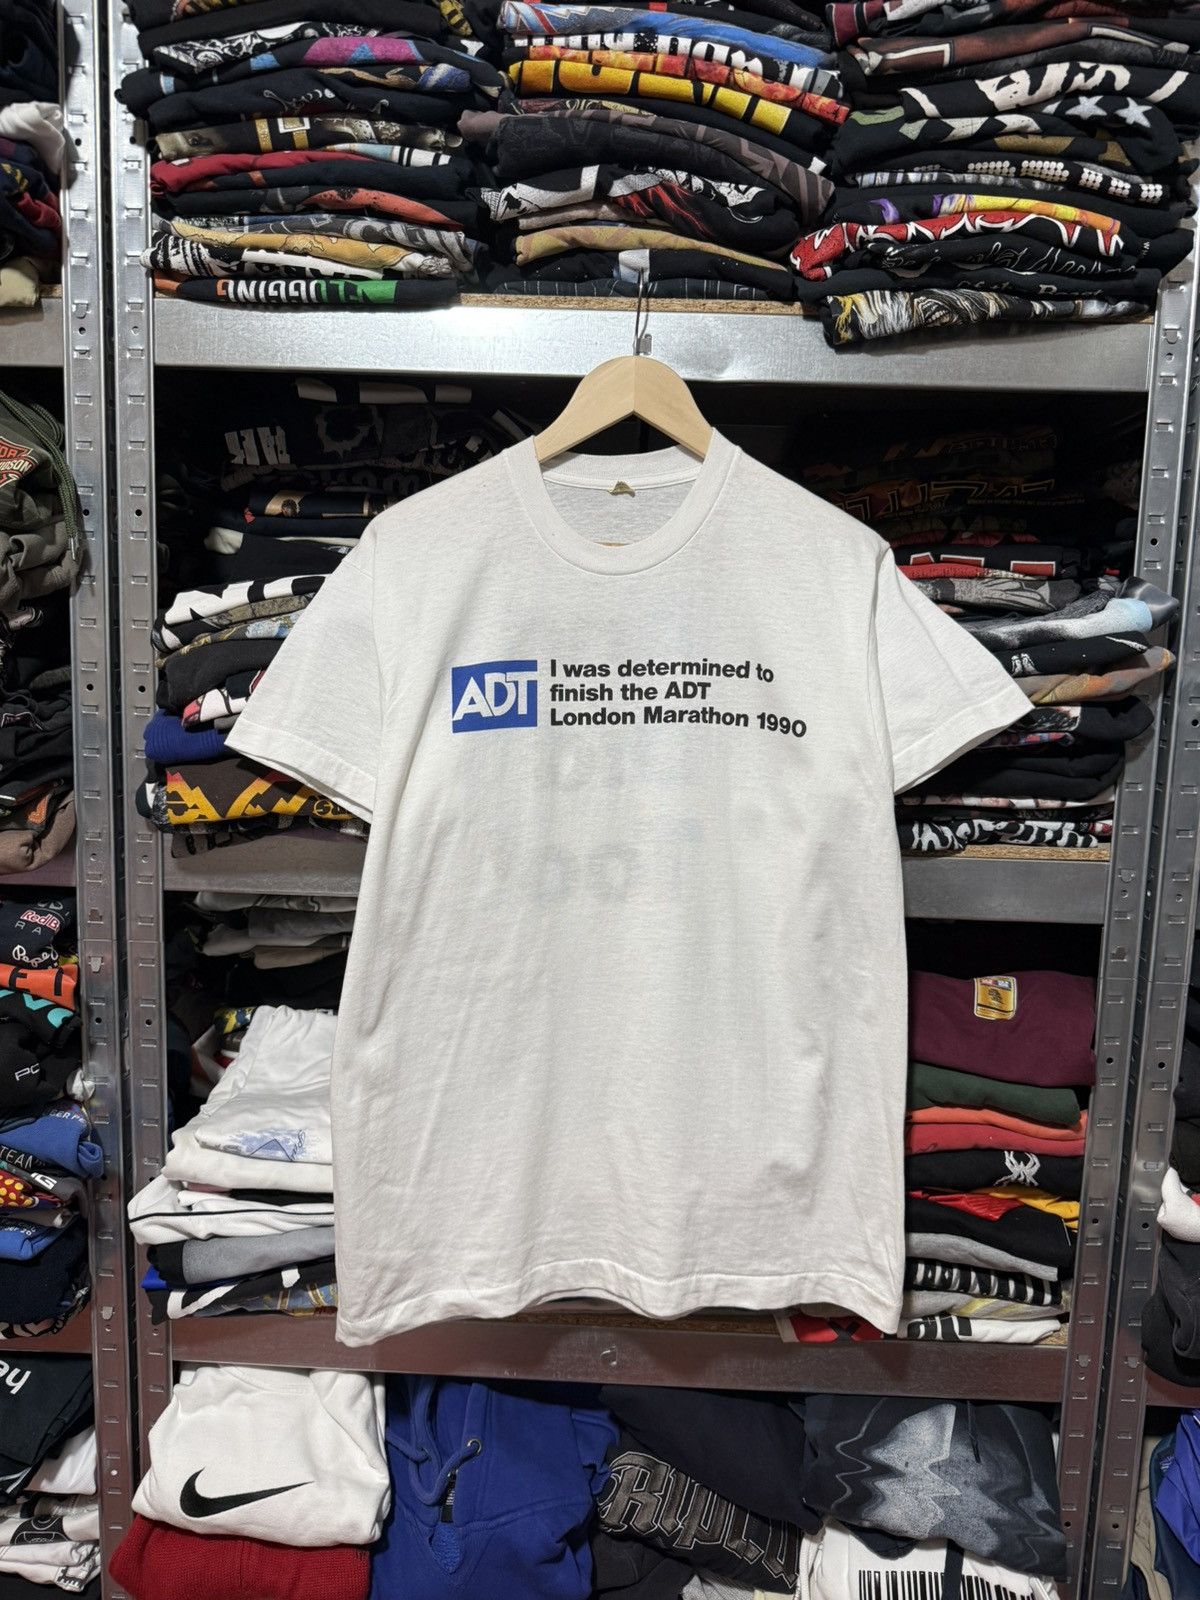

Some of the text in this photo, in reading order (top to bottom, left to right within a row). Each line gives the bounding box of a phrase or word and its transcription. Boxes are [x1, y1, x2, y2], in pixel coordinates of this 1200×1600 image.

[550, 658, 774, 683] I was determined to
[452, 672, 538, 721] ADT
[550, 681, 711, 701] finish the ADT
[550, 706, 807, 738] London Marathon 1990
